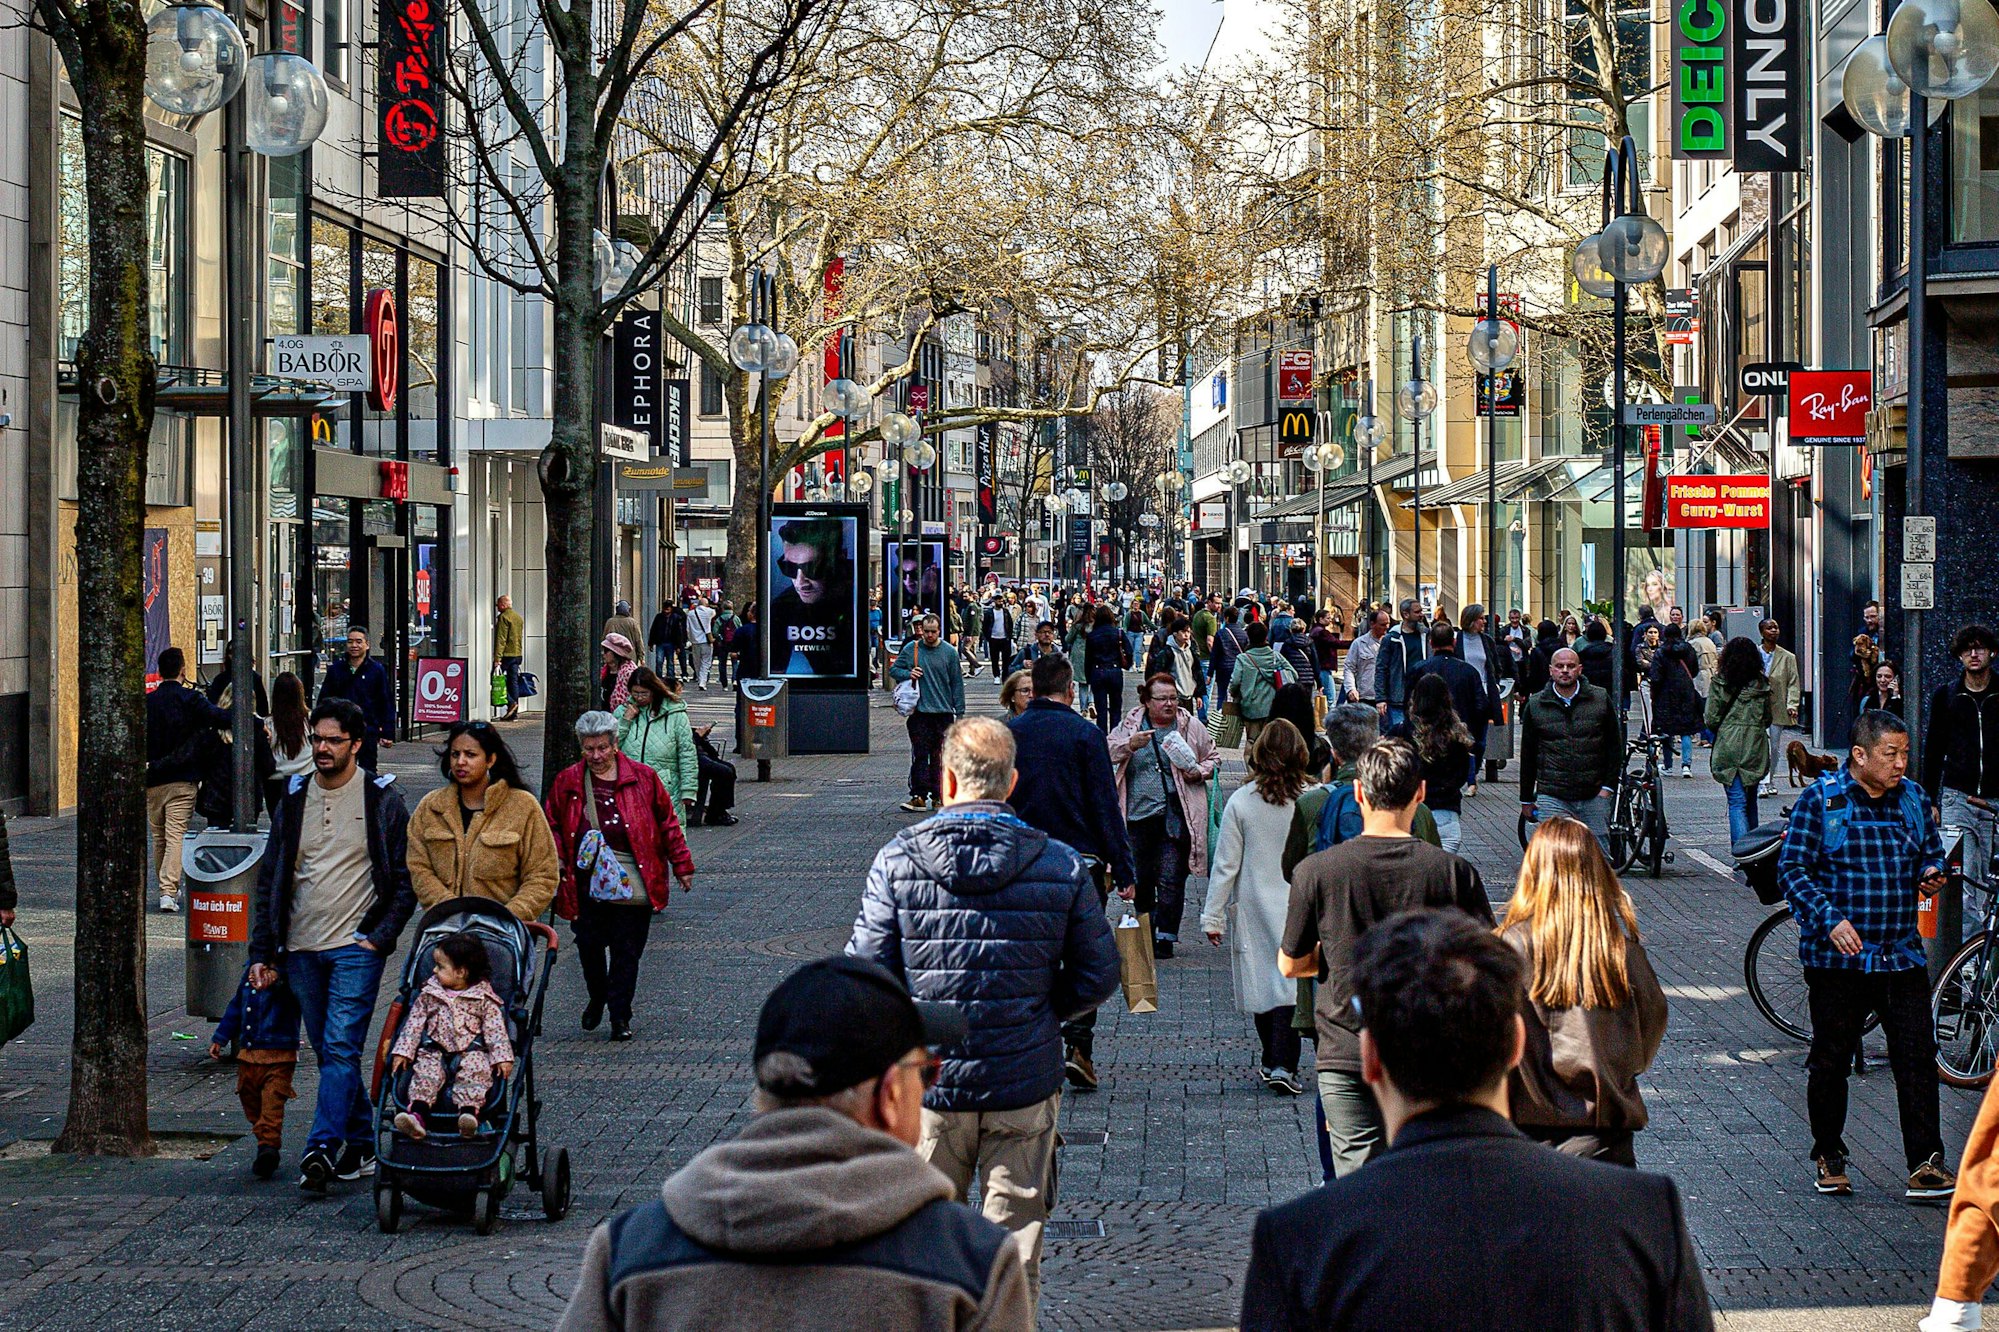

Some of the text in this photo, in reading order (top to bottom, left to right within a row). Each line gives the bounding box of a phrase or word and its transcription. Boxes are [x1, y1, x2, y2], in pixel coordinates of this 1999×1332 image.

[1679, 0, 1725, 150] DEIC
[1745, 0, 1787, 158] ONLY
[278, 339, 304, 349] 4.OG
[1281, 352, 1311, 366] FC
[337, 378, 364, 387] SPA
[1744, 371, 1789, 387] ONL
[1800, 383, 1869, 421] Ray-Ban
[1636, 407, 1705, 423] Perlengäßchen
[668, 384, 680, 468] SKECHE
[1804, 436, 1832, 444] GENUINE
[1670, 484, 1770, 499] Frische Pommes
[1680, 503, 1764, 519] Curry-Wurst
[202, 567, 214, 584] 39
[416, 579, 431, 604] SALE
[199, 602, 223, 617] ABOR
[786, 625, 837, 641] BOSS
[794, 644, 831, 652] EYEWEAR
[420, 670, 460, 703] 0%
[193, 899, 243, 913] Maat üch frei!
[211, 925, 228, 935] AWB
